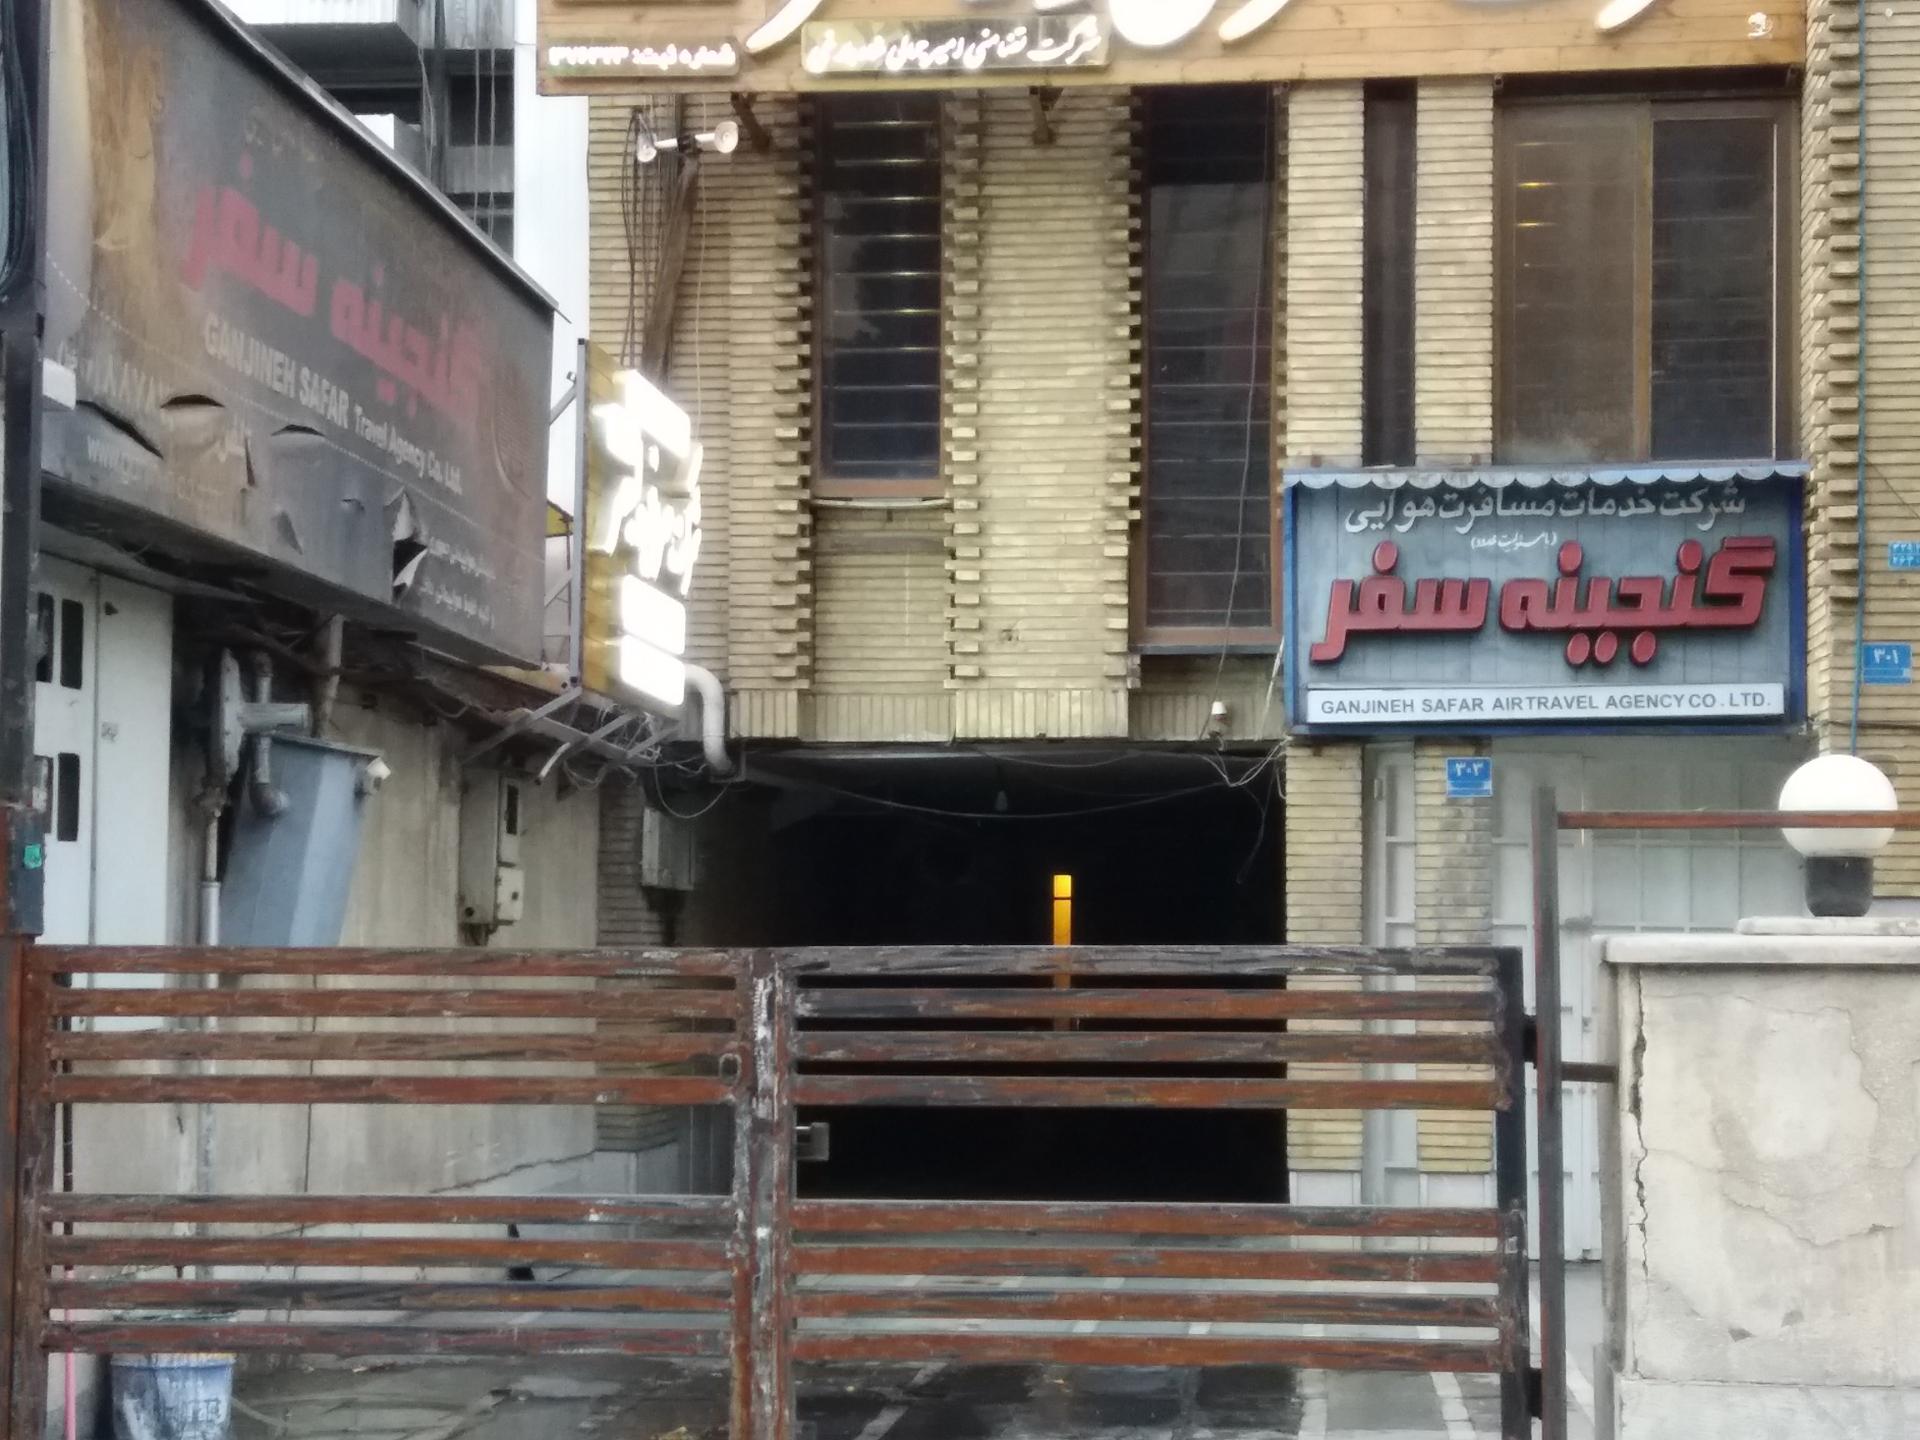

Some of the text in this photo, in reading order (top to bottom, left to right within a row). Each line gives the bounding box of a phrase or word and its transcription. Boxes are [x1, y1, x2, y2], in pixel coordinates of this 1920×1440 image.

[182, 150, 318, 316] سفر
[203, 311, 297, 399] GANJINEH
[299, 366, 349, 430] SAFAR
[1344, 480, 1746, 534] شرکت خدمات مسافرت هوایی
[1309, 536, 1776, 666] گنجینه سفر
[1321, 699, 1415, 714] GANJINEH
[1421, 697, 1484, 713] SAFAR
